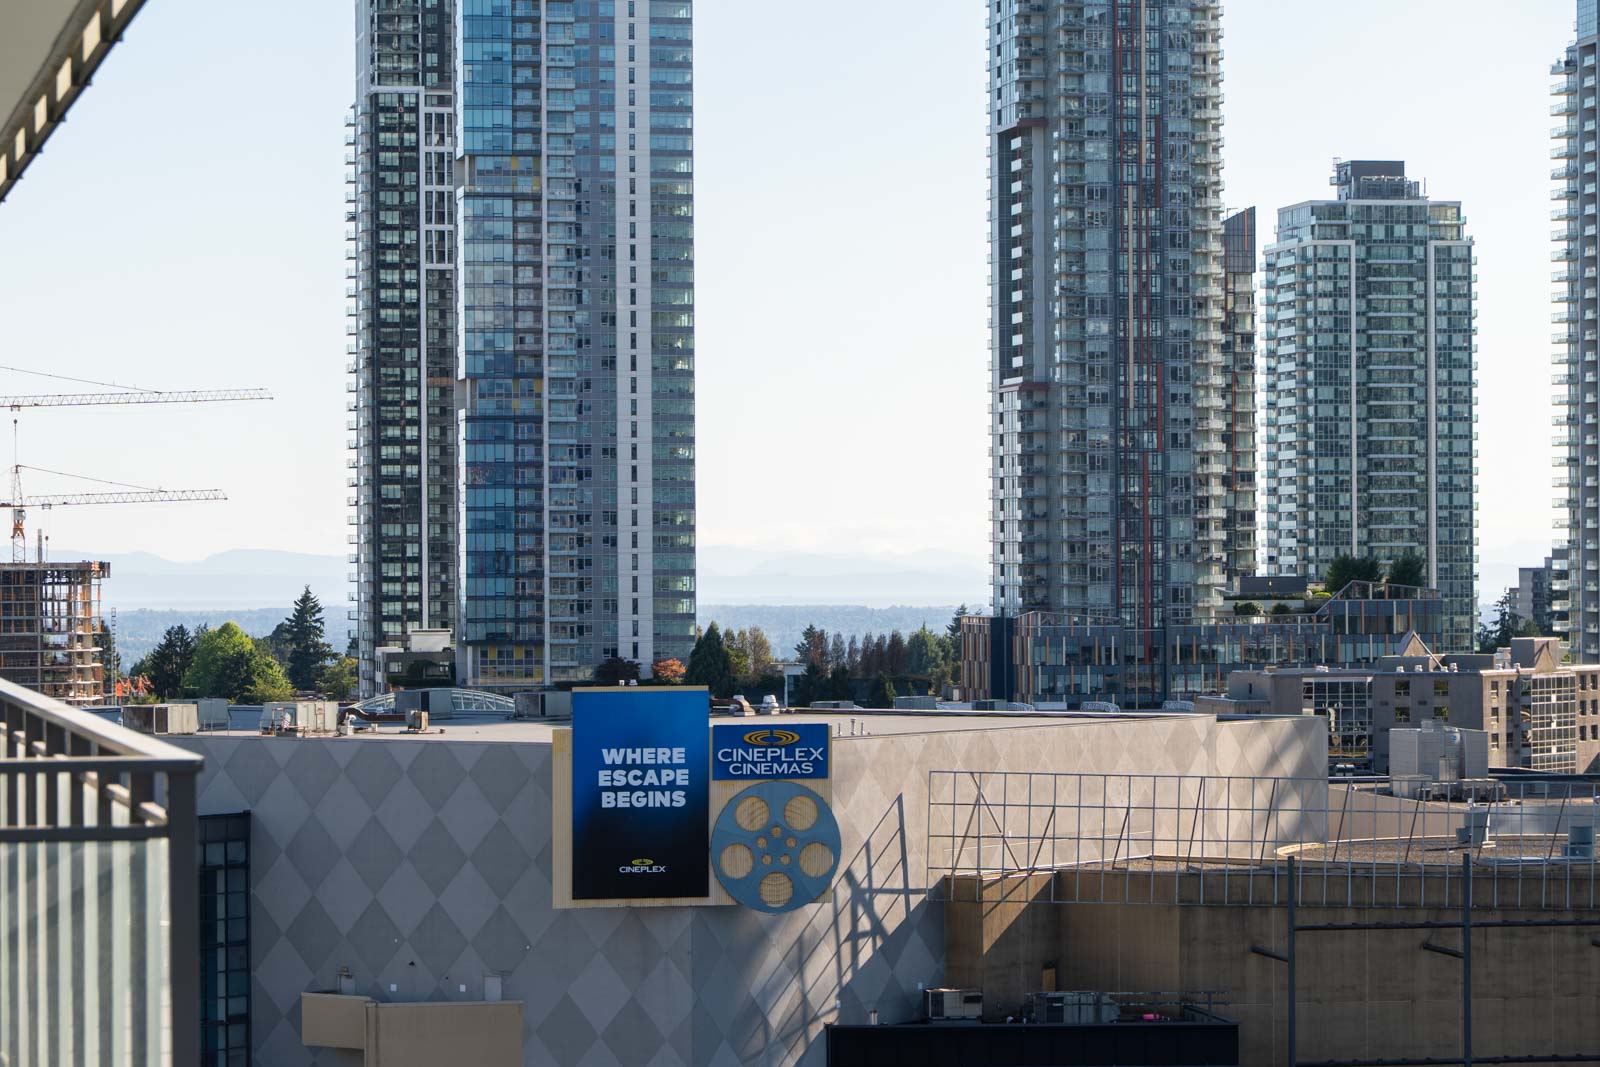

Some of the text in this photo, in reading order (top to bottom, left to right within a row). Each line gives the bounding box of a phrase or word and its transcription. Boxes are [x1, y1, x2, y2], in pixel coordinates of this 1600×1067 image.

[601, 747, 686, 765] WHERE
[717, 747, 824, 762] CINEPLEX
[728, 762, 814, 775] CINEMAS
[598, 769, 689, 787] ESCAPE
[601, 790, 686, 808] BEGINS
[619, 865, 666, 873] CINEPLEX
